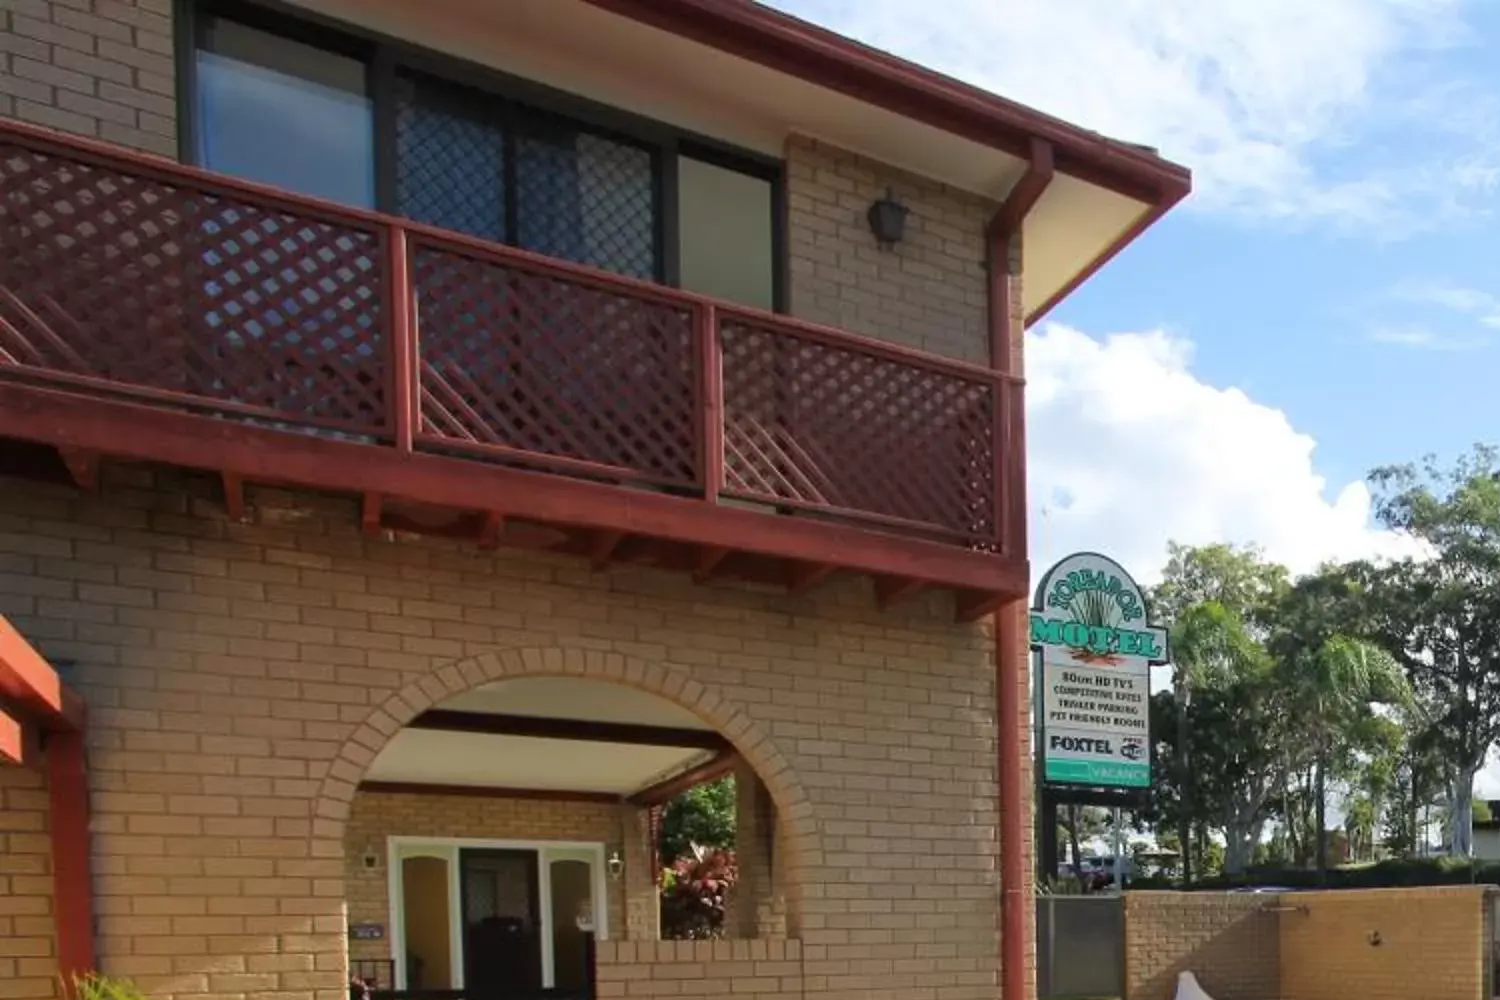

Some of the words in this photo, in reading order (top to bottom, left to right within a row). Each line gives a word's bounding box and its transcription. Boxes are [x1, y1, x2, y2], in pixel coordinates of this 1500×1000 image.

[1031, 615, 1162, 658] MOTEL
[1095, 675, 1111, 687] HD
[1098, 703, 1138, 715] PARKING
[1050, 711, 1067, 721] PET
[1069, 713, 1111, 725] FRIENDLY
[1113, 718, 1145, 729] ROOMS
[1050, 735, 1113, 754] FOXTEL
